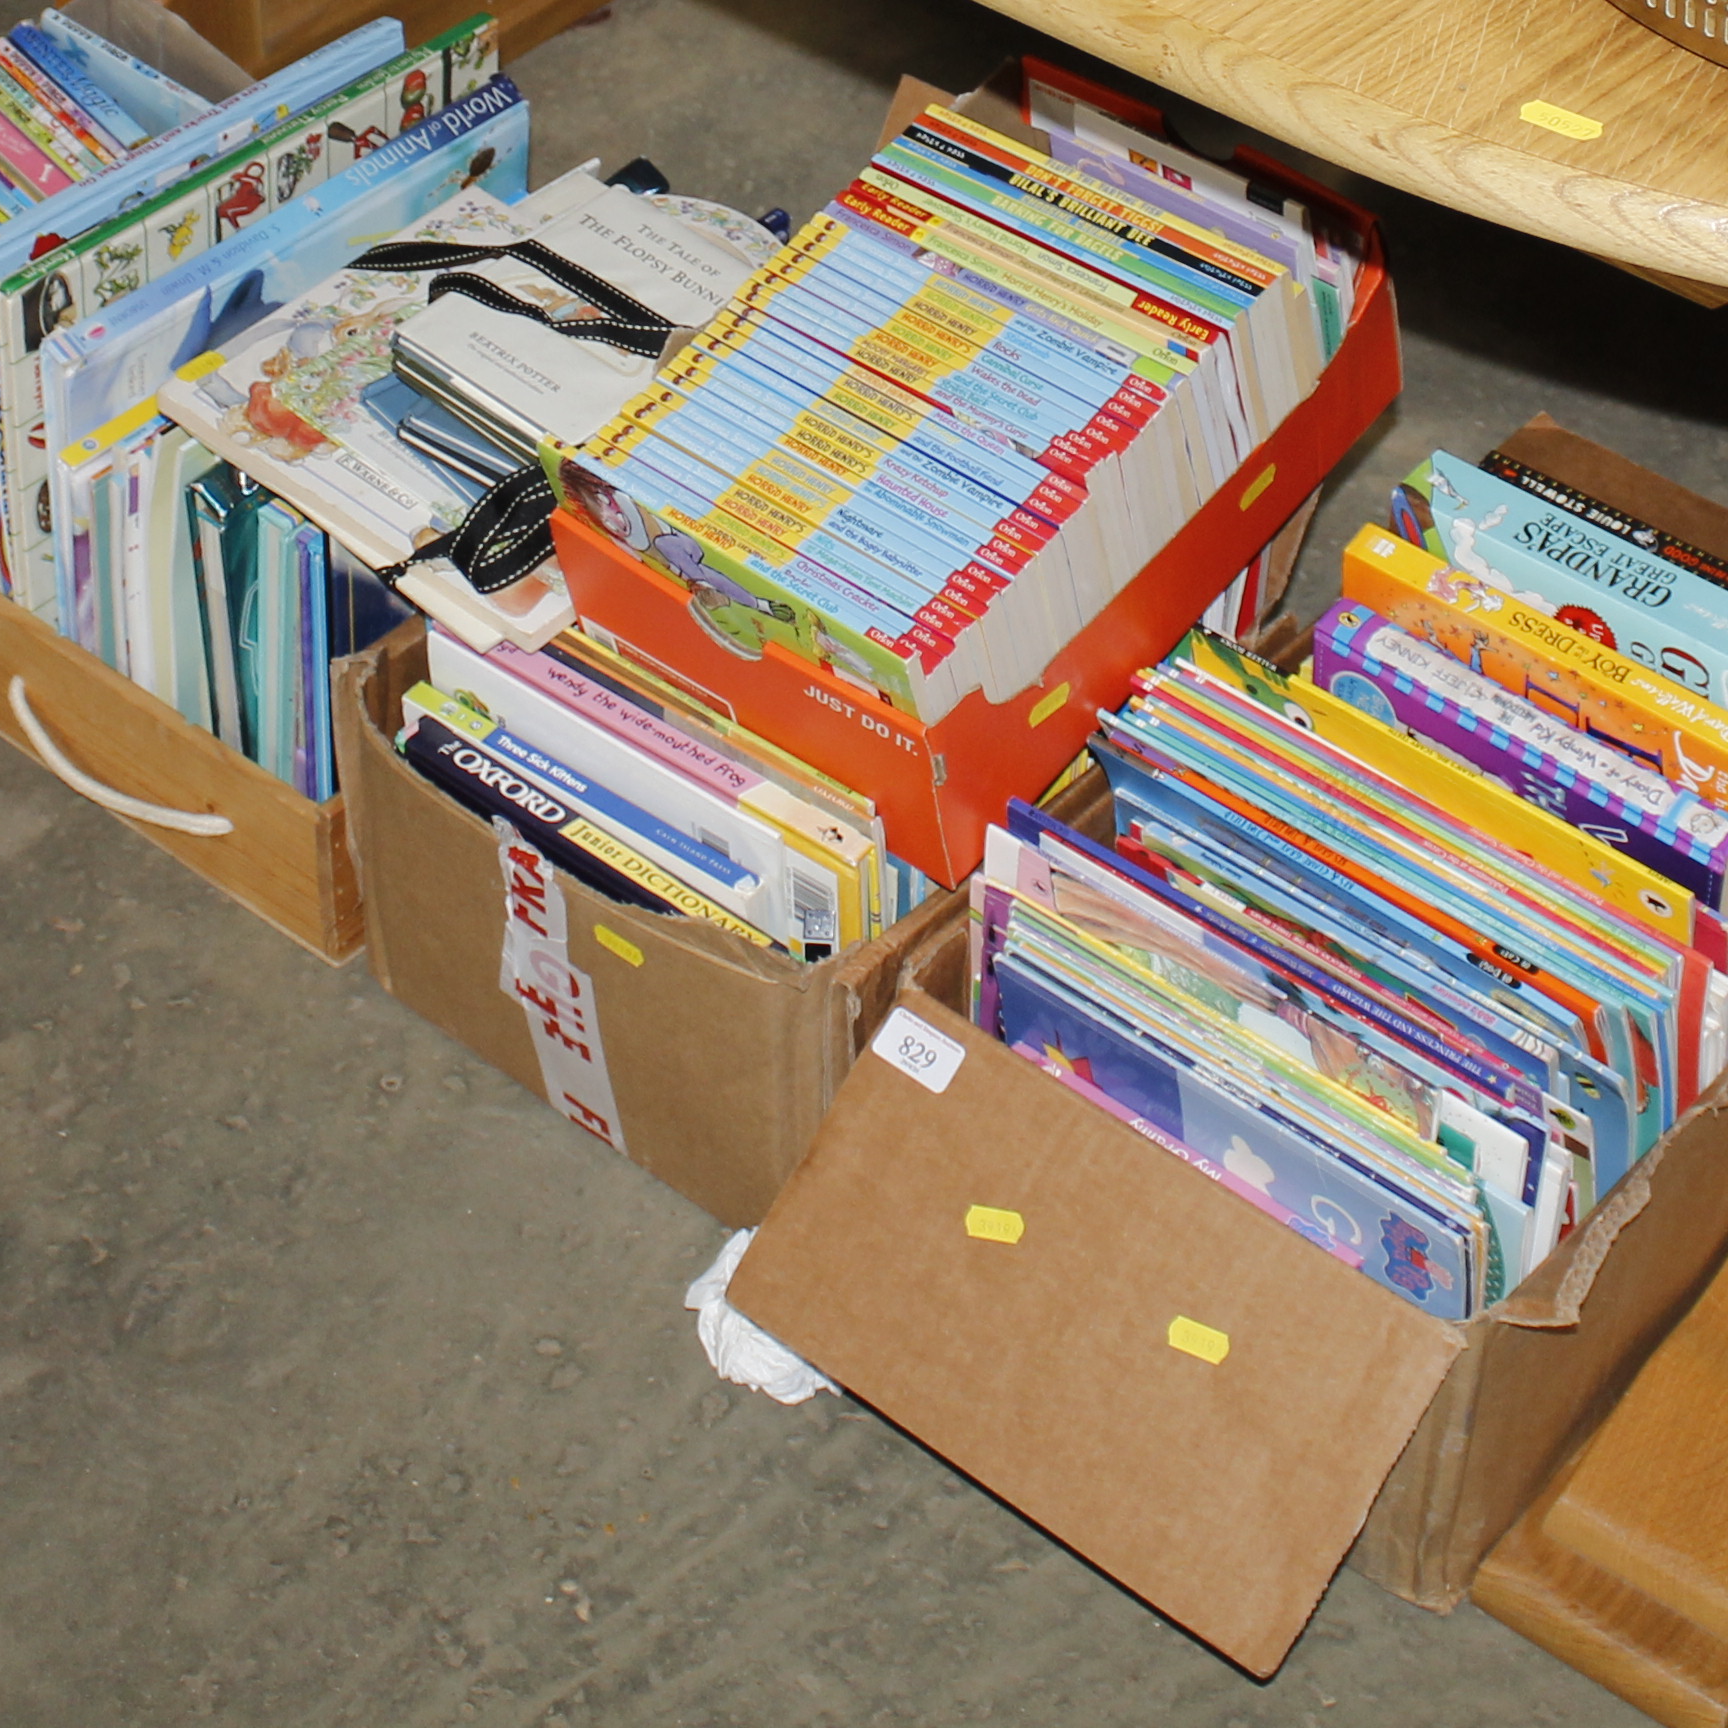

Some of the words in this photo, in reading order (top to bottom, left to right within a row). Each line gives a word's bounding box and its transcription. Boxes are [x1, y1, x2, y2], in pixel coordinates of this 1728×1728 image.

[441, 81, 520, 136] World
[344, 129, 433, 186] Animals
[841, 193, 876, 215] Early
[871, 207, 912, 234] Reader
[890, 196, 929, 221] Reader
[1007, 172, 1059, 205] BILAL'S
[1055, 194, 1127, 236] BRILLIANT
[1124, 223, 1156, 248] BEE
[1025, 163, 1065, 187] DON'T
[1061, 179, 1119, 212] FORGET
[1115, 205, 1165, 235] TIGGS!
[578, 213, 616, 240] THE
[611, 234, 675, 275] FLOPSY
[989, 192, 1044, 227] BARKING
[1045, 218, 1077, 241] FOR
[1073, 229, 1125, 264] BAGELS
[637, 223, 667, 246] THE
[667, 240, 702, 267] TALE
[700, 264, 722, 278] OF
[994, 285, 1027, 309] HENRY
[1027, 281, 1069, 312] Henry's
[1065, 300, 1105, 328] Holiday
[1135, 297, 1183, 325] Reader
[1170, 313, 1210, 342] Early
[1035, 328, 1074, 355] Zombie
[1073, 342, 1119, 377] Vampire
[515, 361, 562, 394] POTTER
[874, 474, 915, 501] Haunted
[913, 495, 949, 519] House
[1520, 475, 1589, 515] STOWELL
[1538, 511, 1611, 557] ESCAPE
[1586, 508, 1634, 537] LOUIE
[1513, 520, 1673, 610] GRANDPA'S
[1610, 550, 1679, 586] GREAT
[784, 574, 819, 603] Secret
[815, 593, 840, 615] Club
[794, 559, 846, 590] Christmas
[841, 582, 881, 614] Cracker
[869, 627, 896, 649] Orion
[1508, 610, 1581, 657] DRESS
[1376, 634, 1433, 675] KINNEY
[1587, 650, 1634, 685] BOY
[1430, 662, 1476, 694] JEFF
[548, 666, 590, 698] wendy
[591, 688, 618, 712] the
[618, 703, 718, 766] wide-mouthed
[803, 683, 856, 722] JUST
[860, 711, 891, 739] DO
[436, 739, 461, 757] The
[1531, 721, 1560, 744] Kid
[1551, 731, 1598, 770] Wimpy
[495, 734, 529, 761] Three
[524, 750, 553, 774] Sick
[547, 762, 589, 794] Kittens
[452, 746, 568, 825] OXFORD
[1618, 773, 1665, 808] Diary
[567, 822, 622, 863] Junior
[620, 856, 761, 945] DICTIONARY
[1327, 980, 1367, 1011] WIZARD
[897, 1035, 938, 1069] 829
[1408, 1026, 1461, 1063] PRINCESS
